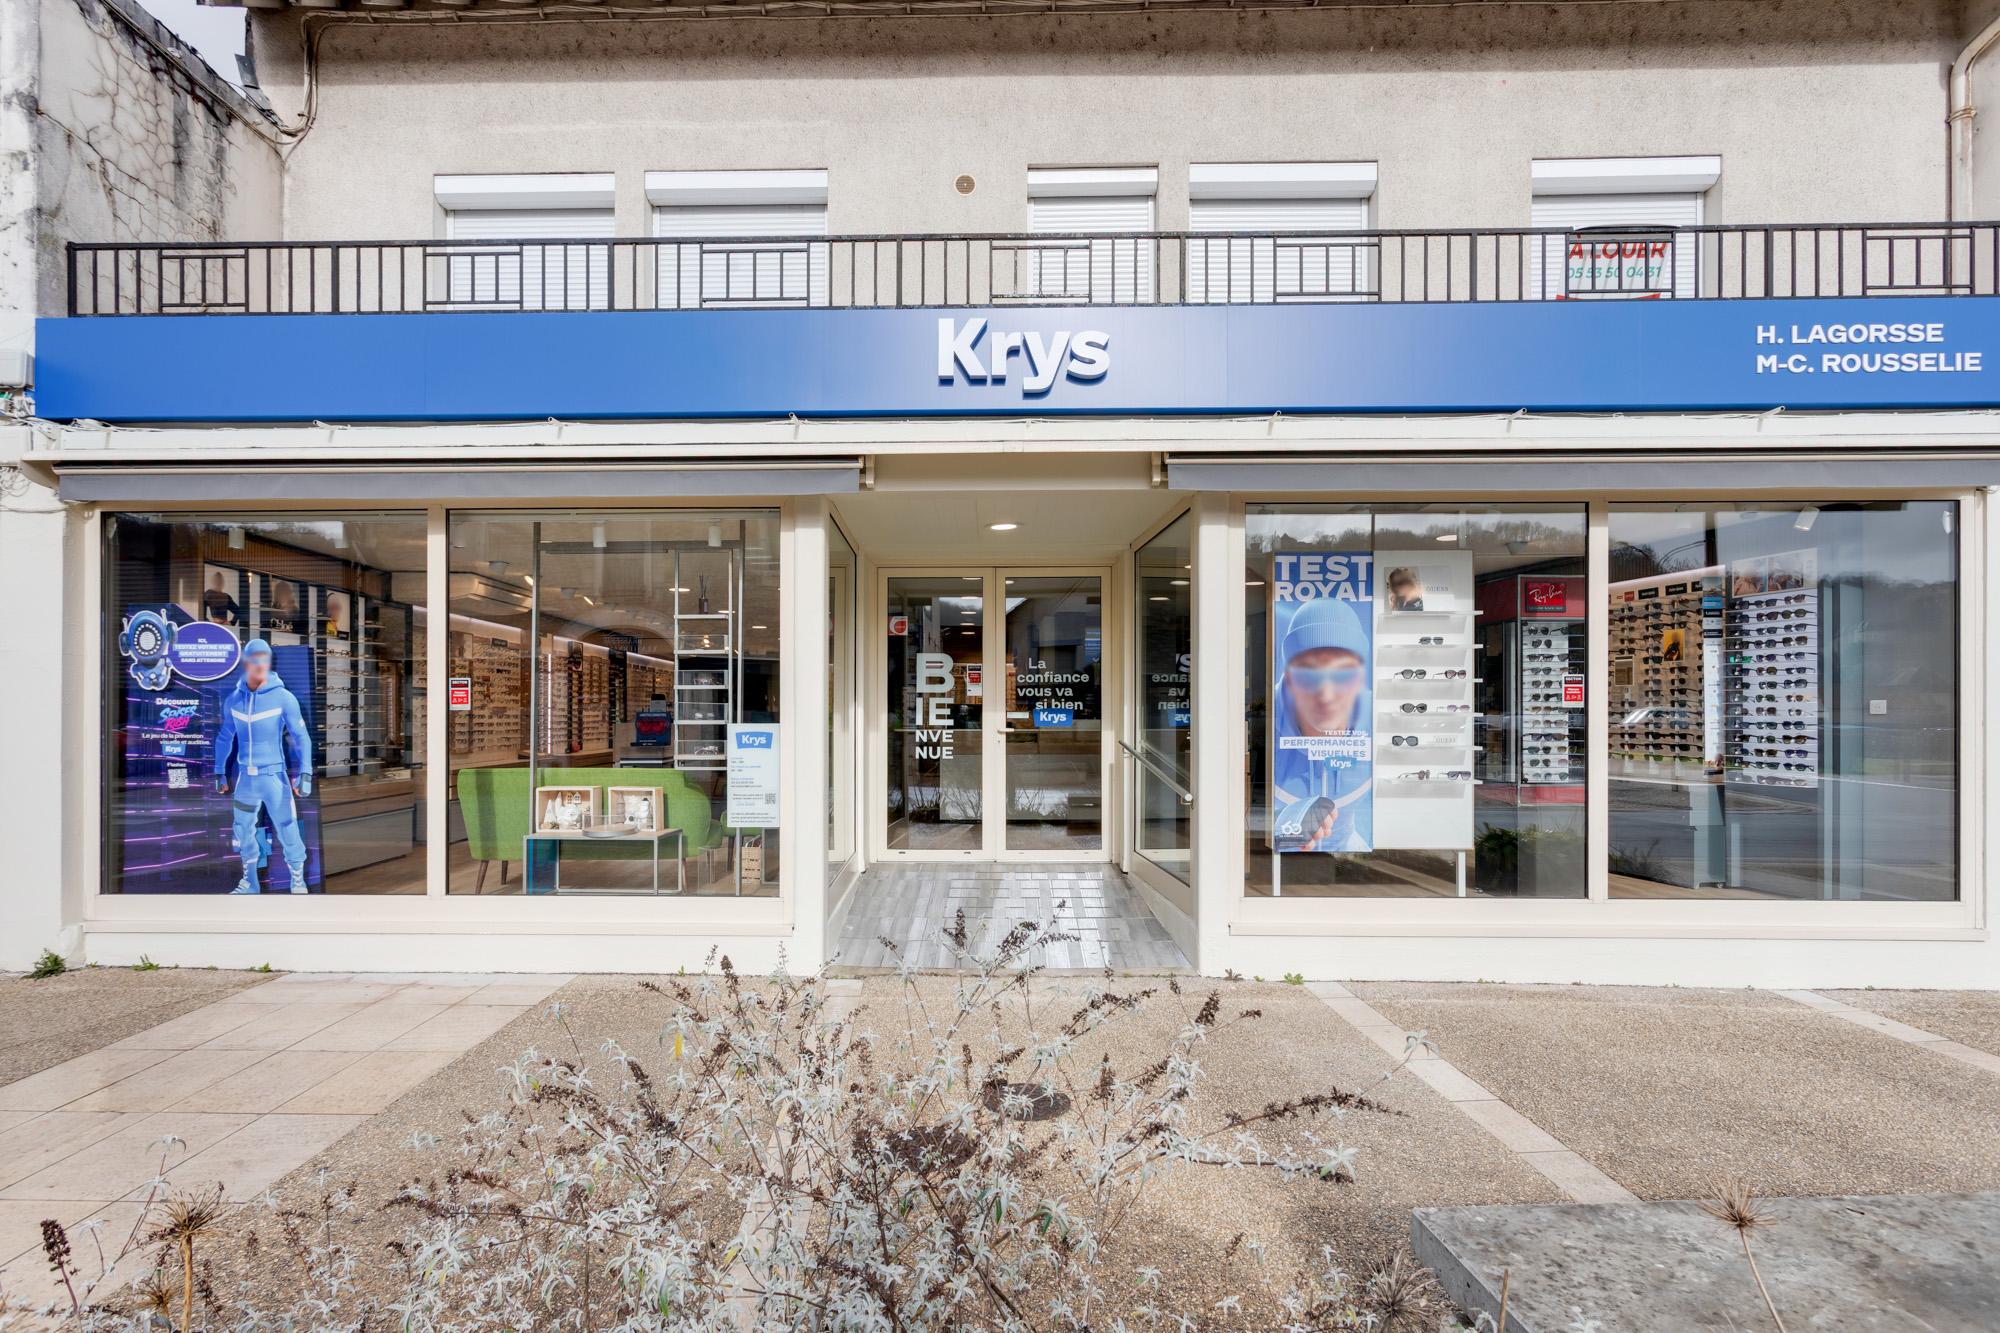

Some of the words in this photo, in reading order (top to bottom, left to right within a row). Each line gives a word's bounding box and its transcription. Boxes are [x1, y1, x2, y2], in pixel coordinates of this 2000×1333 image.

[1626, 265, 1645, 278] 04
[1756, 325, 1784, 345] H.
[1791, 323, 1945, 344] LAGORSSE
[938, 317, 1111, 397] Krys
[1756, 354, 1815, 374] M-C.
[1821, 352, 1983, 373] ROUSSELIE
[1275, 555, 1373, 581] TEST
[1274, 581, 1373, 602] ROYAL
[1028, 657, 1047, 669] La
[1016, 671, 1090, 683] confiance
[1017, 687, 1053, 697] vous
[1055, 687, 1074, 697] va
[155, 697, 200, 706] Découvrez
[1035, 699, 1048, 710] si
[1051, 699, 1084, 710] bien
[1039, 711, 1067, 724] Krys
[741, 734, 767, 746] Krys
[1283, 739, 1367, 747] PERFORMANCES
[165, 746, 182, 754] Krys
[1310, 750, 1367, 758] VISUELLES
[1330, 759, 1352, 769] Krys
